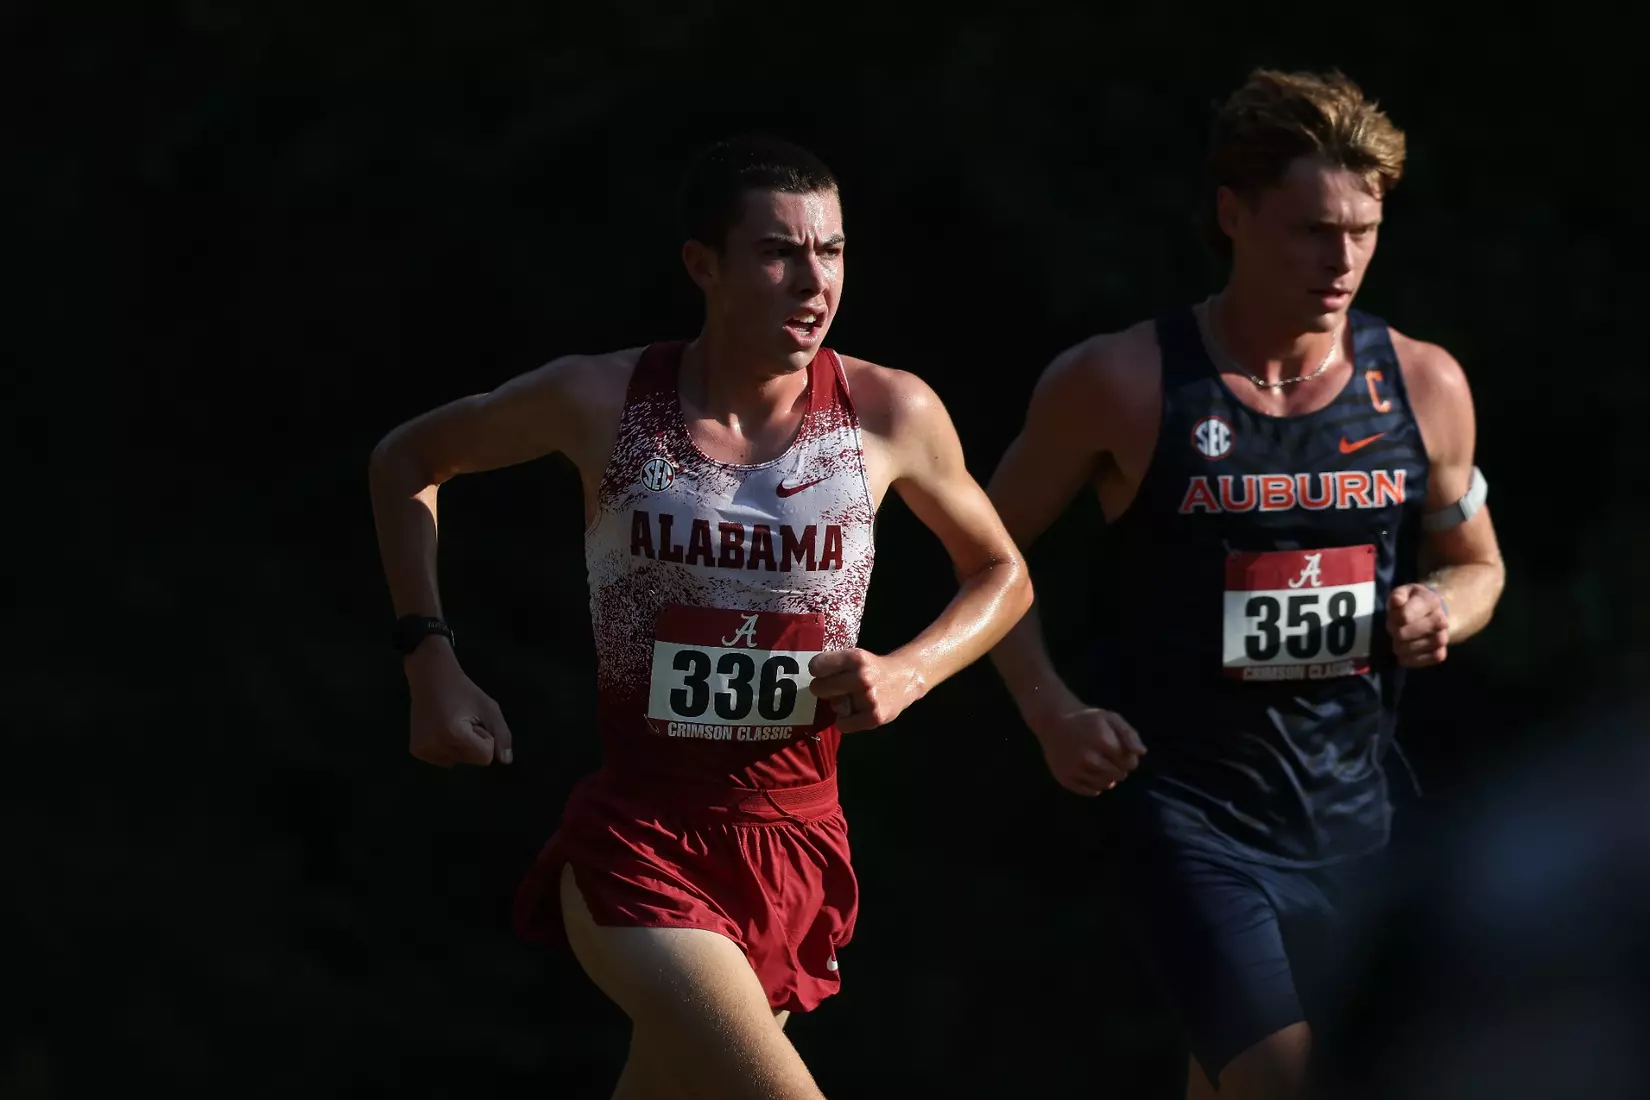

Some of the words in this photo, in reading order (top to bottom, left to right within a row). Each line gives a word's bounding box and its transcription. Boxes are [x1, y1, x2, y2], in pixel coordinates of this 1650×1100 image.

[1195, 419, 1231, 457] SEC
[643, 460, 673, 490] SEC
[1178, 469, 1407, 514] AUBURN
[630, 510, 843, 572] ALABAMA
[1288, 552, 1323, 588] A
[721, 613, 759, 647] A
[1244, 591, 1357, 661] 358
[670, 650, 800, 721] 336
[667, 721, 733, 741] CRIMSON
[736, 725, 793, 742] CLASSIC
